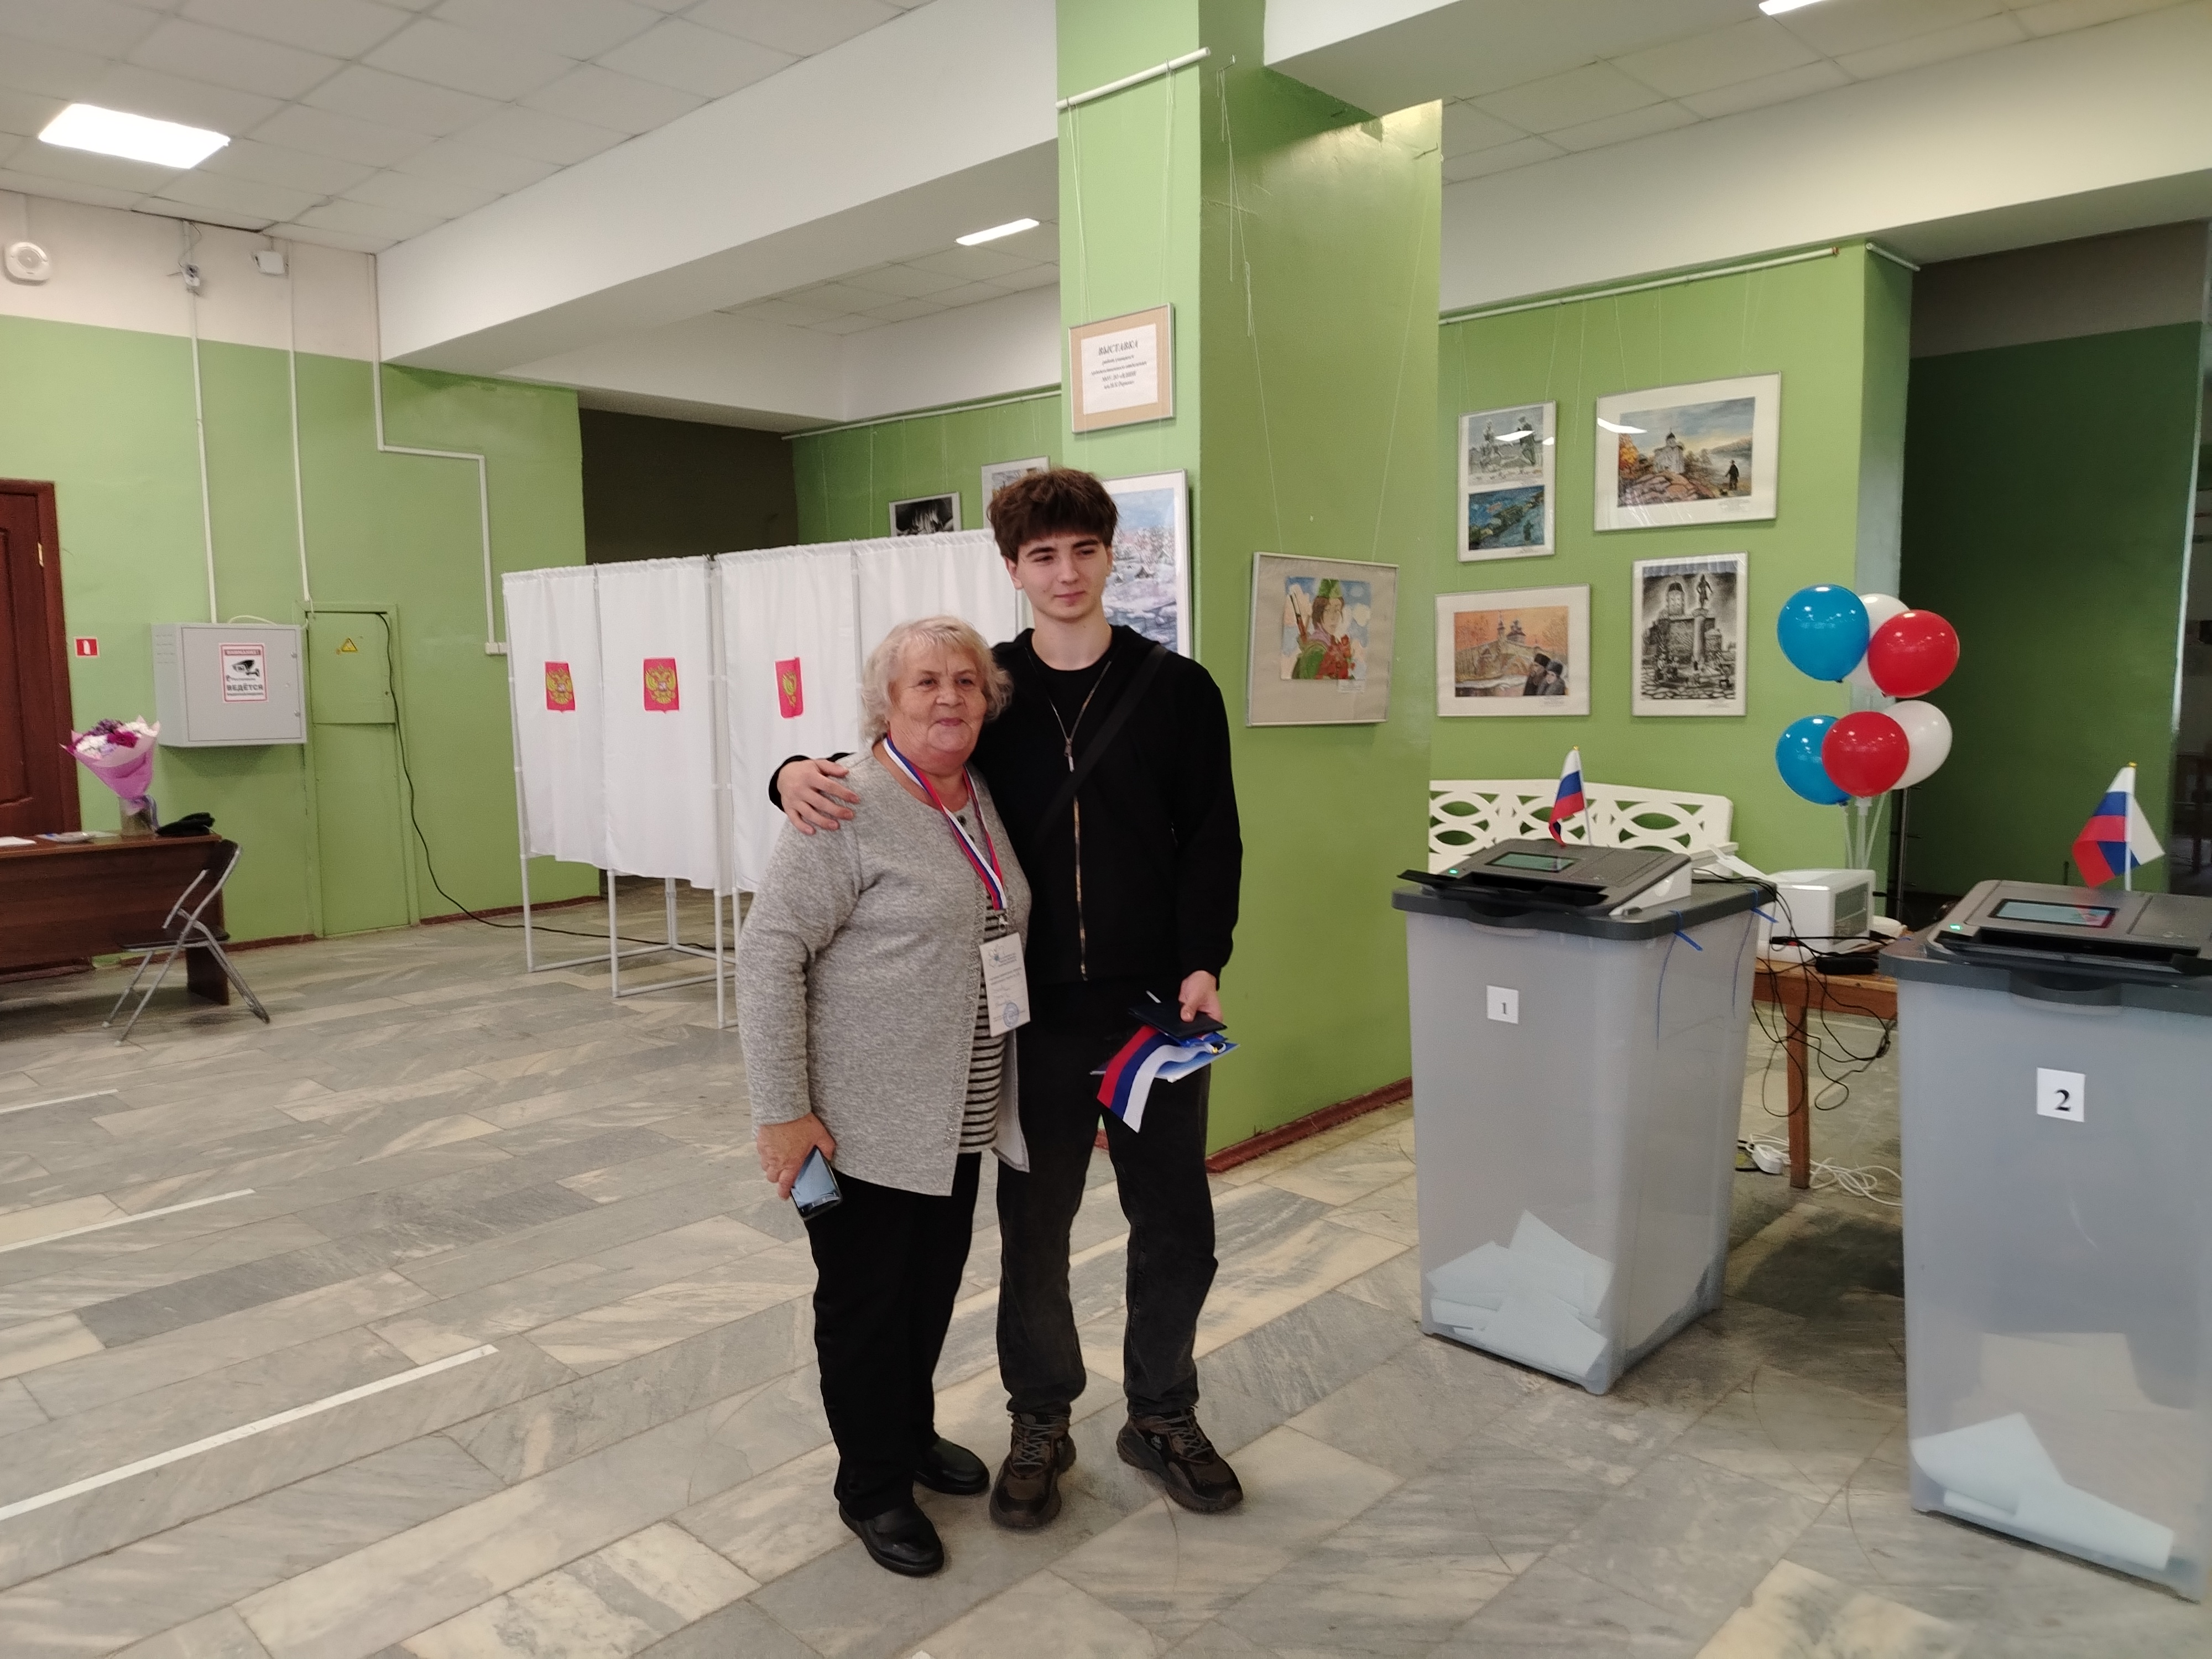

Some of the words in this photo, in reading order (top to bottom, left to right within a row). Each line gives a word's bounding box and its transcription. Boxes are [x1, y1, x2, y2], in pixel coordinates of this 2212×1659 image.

[226, 683, 263, 691] ВЕДЁТСЯ
[1501, 1002, 1507, 1015] 1
[2054, 1089, 2071, 1112] 2
